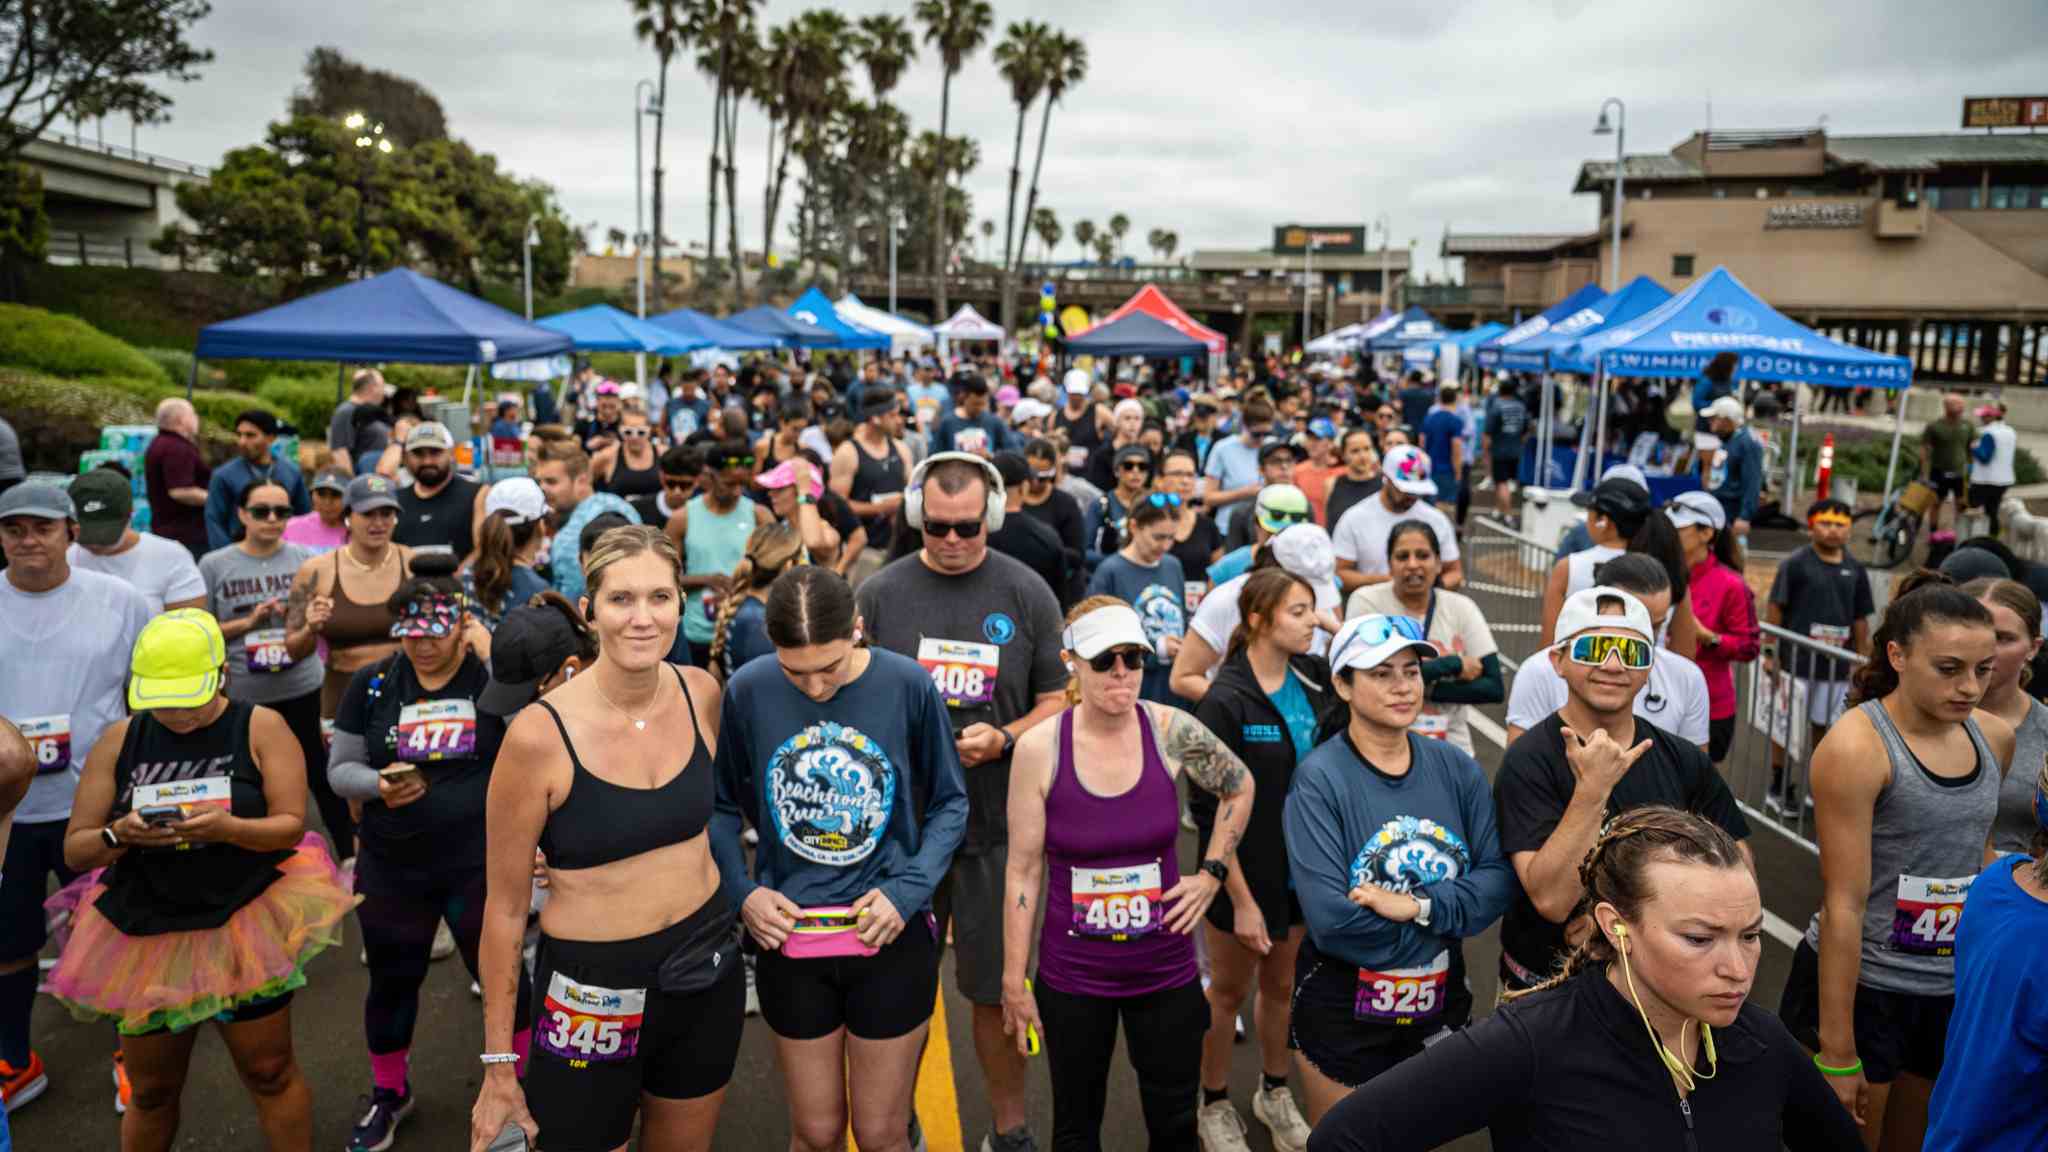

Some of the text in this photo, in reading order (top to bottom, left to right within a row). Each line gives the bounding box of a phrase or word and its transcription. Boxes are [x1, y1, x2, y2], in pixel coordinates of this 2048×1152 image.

[1843, 364, 1909, 381] GYMS
[931, 664, 985, 698] 408
[407, 722, 465, 751] 477
[1086, 895, 1151, 929] 469
[1911, 909, 1962, 942] 42
[1371, 979, 1437, 1012] 325
[548, 1010, 624, 1055] 345
[569, 1059, 589, 1069] 10K
